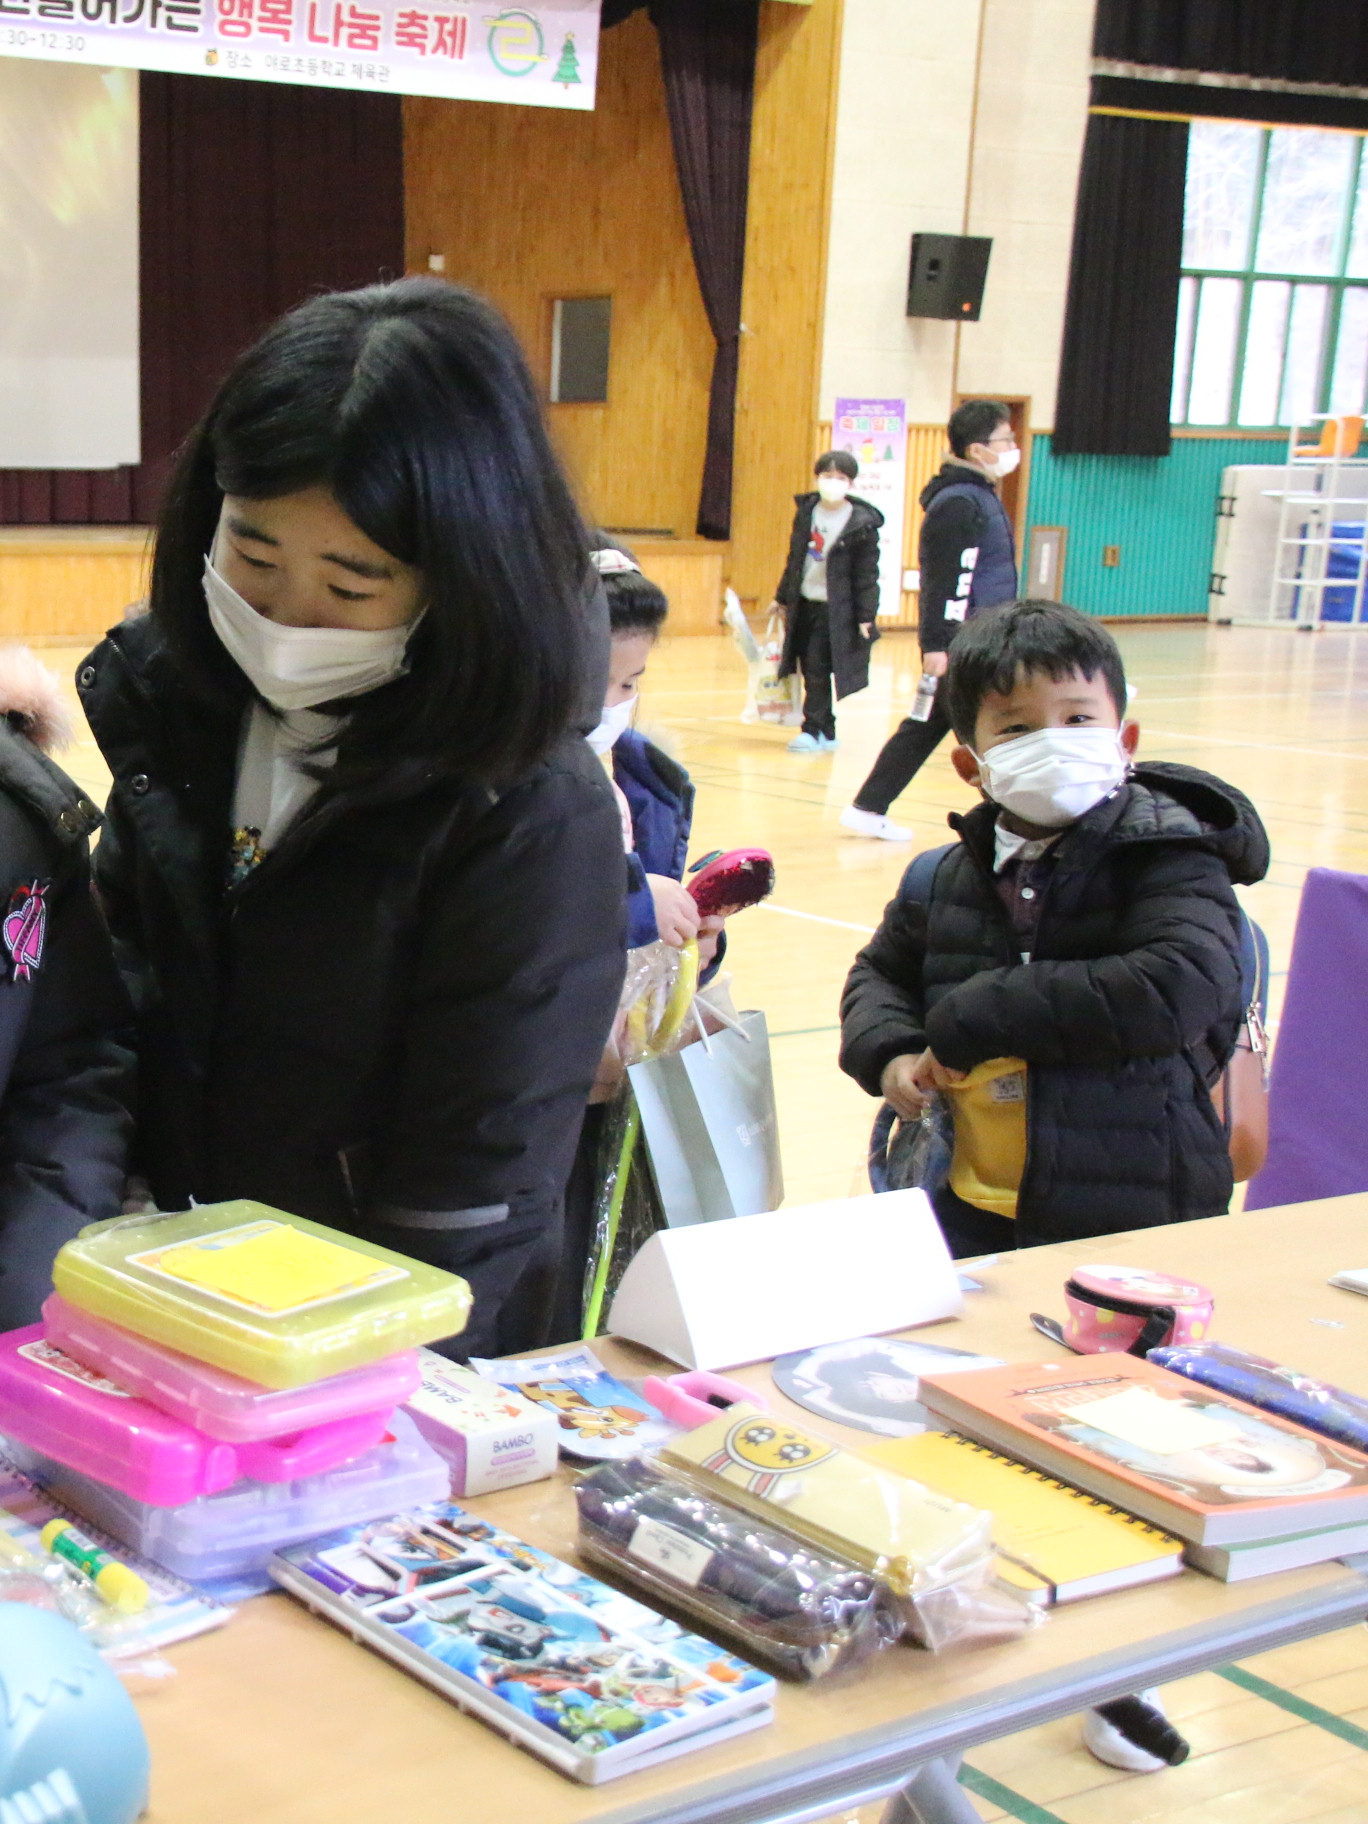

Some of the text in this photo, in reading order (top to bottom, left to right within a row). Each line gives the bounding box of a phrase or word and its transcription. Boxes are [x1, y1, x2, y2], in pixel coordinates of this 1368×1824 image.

[217, 0, 293, 42] 행복
[307, 1, 382, 51] 나눔
[395, 9, 467, 60] 축제
[226, 50, 253, 69] 장소
[492, 1432, 535, 1453] BAMBO
